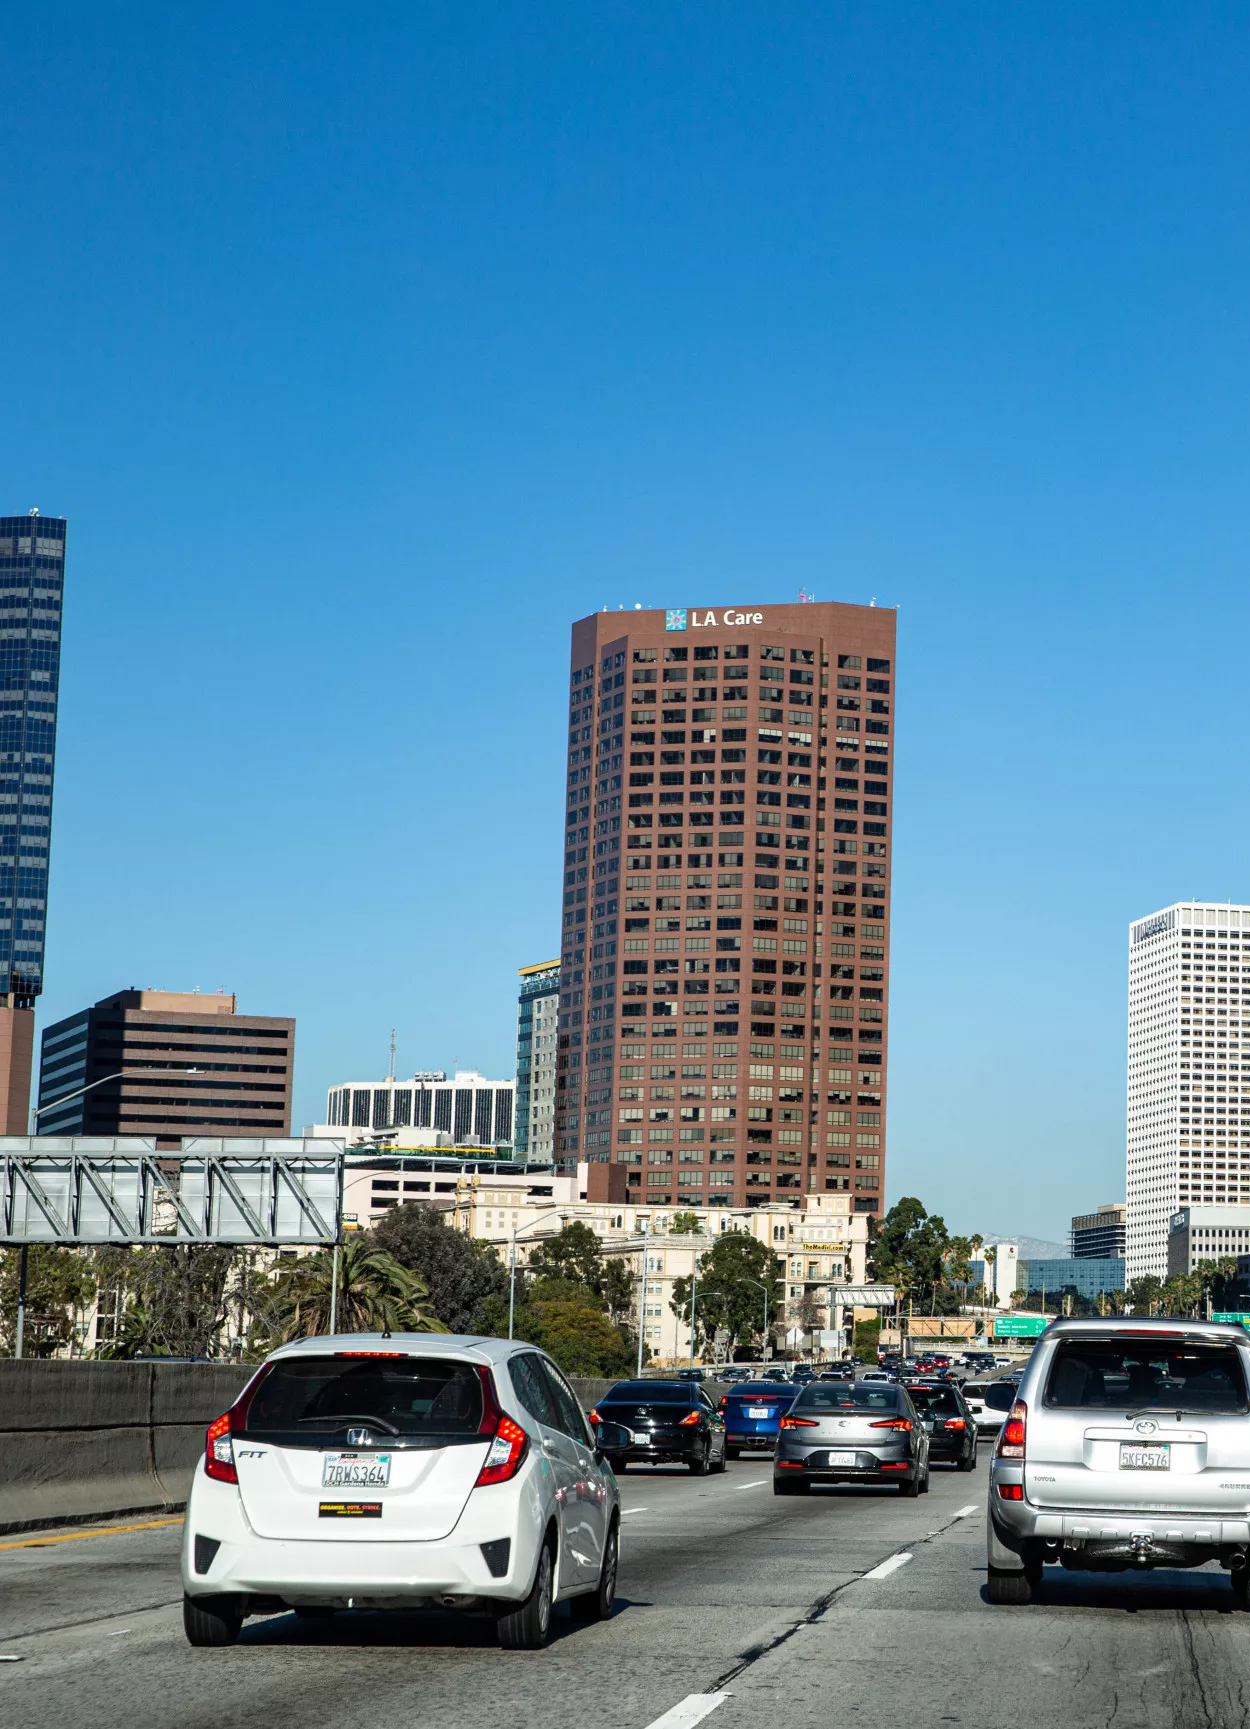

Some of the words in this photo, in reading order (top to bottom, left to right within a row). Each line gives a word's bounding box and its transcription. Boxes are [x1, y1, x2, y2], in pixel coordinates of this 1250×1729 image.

[723, 610, 763, 626] Care
[238, 1450, 269, 1458] FIT
[1122, 1452, 1168, 1467] 5KFC576
[328, 1465, 385, 1481] 7RWS364
